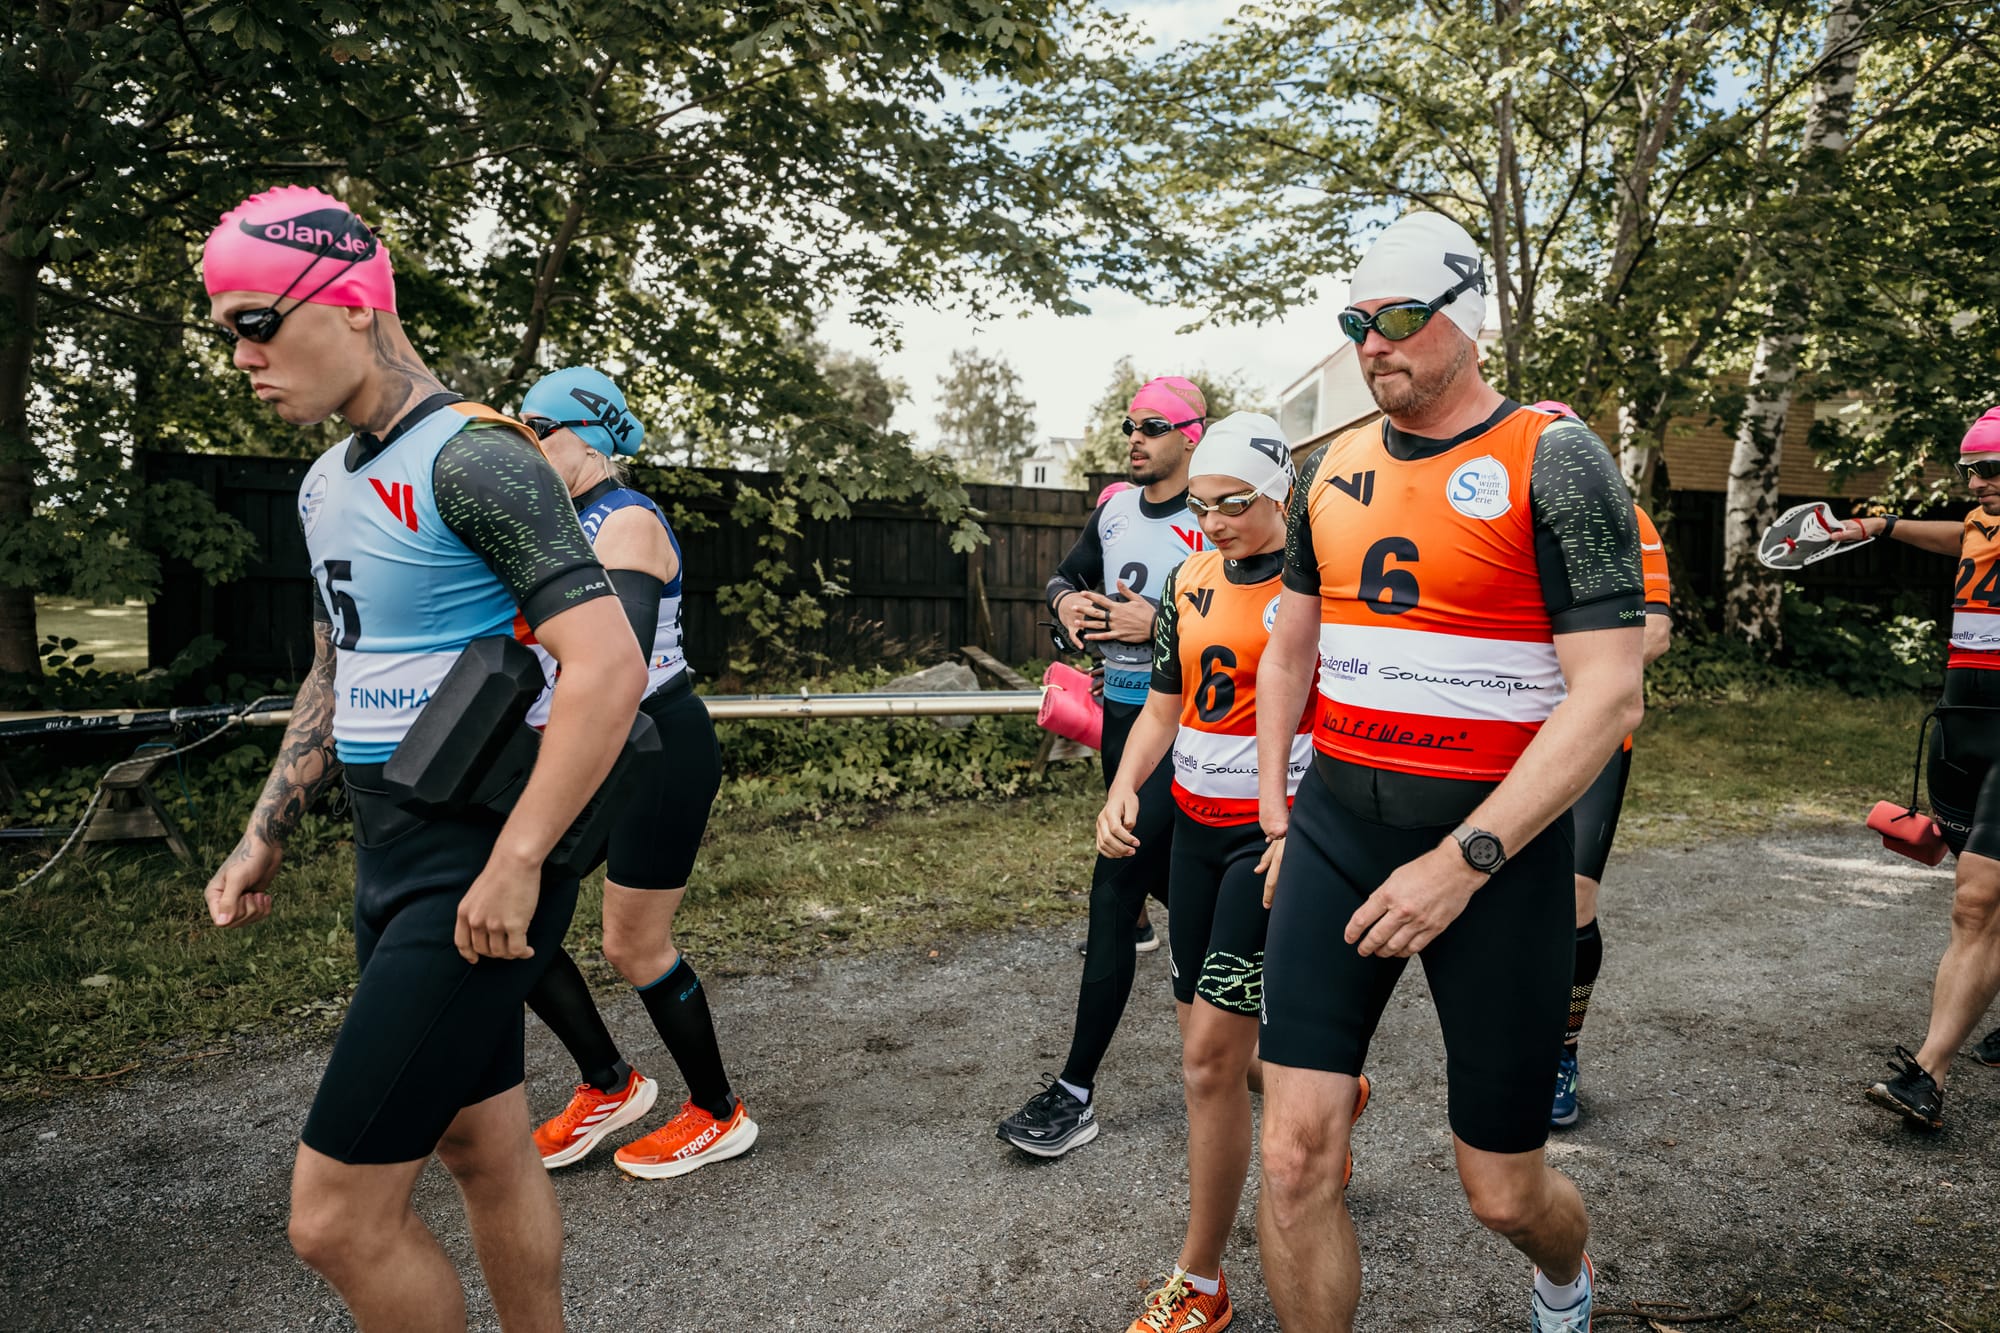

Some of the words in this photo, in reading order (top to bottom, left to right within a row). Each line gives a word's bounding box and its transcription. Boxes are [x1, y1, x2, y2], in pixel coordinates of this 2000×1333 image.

[569, 387, 635, 442] ARK
[1119, 562, 1148, 594] 2
[1358, 536, 1420, 615] 6
[1955, 558, 2000, 607] 24
[1195, 645, 1237, 723] 6
[672, 1122, 721, 1162] TERREX
